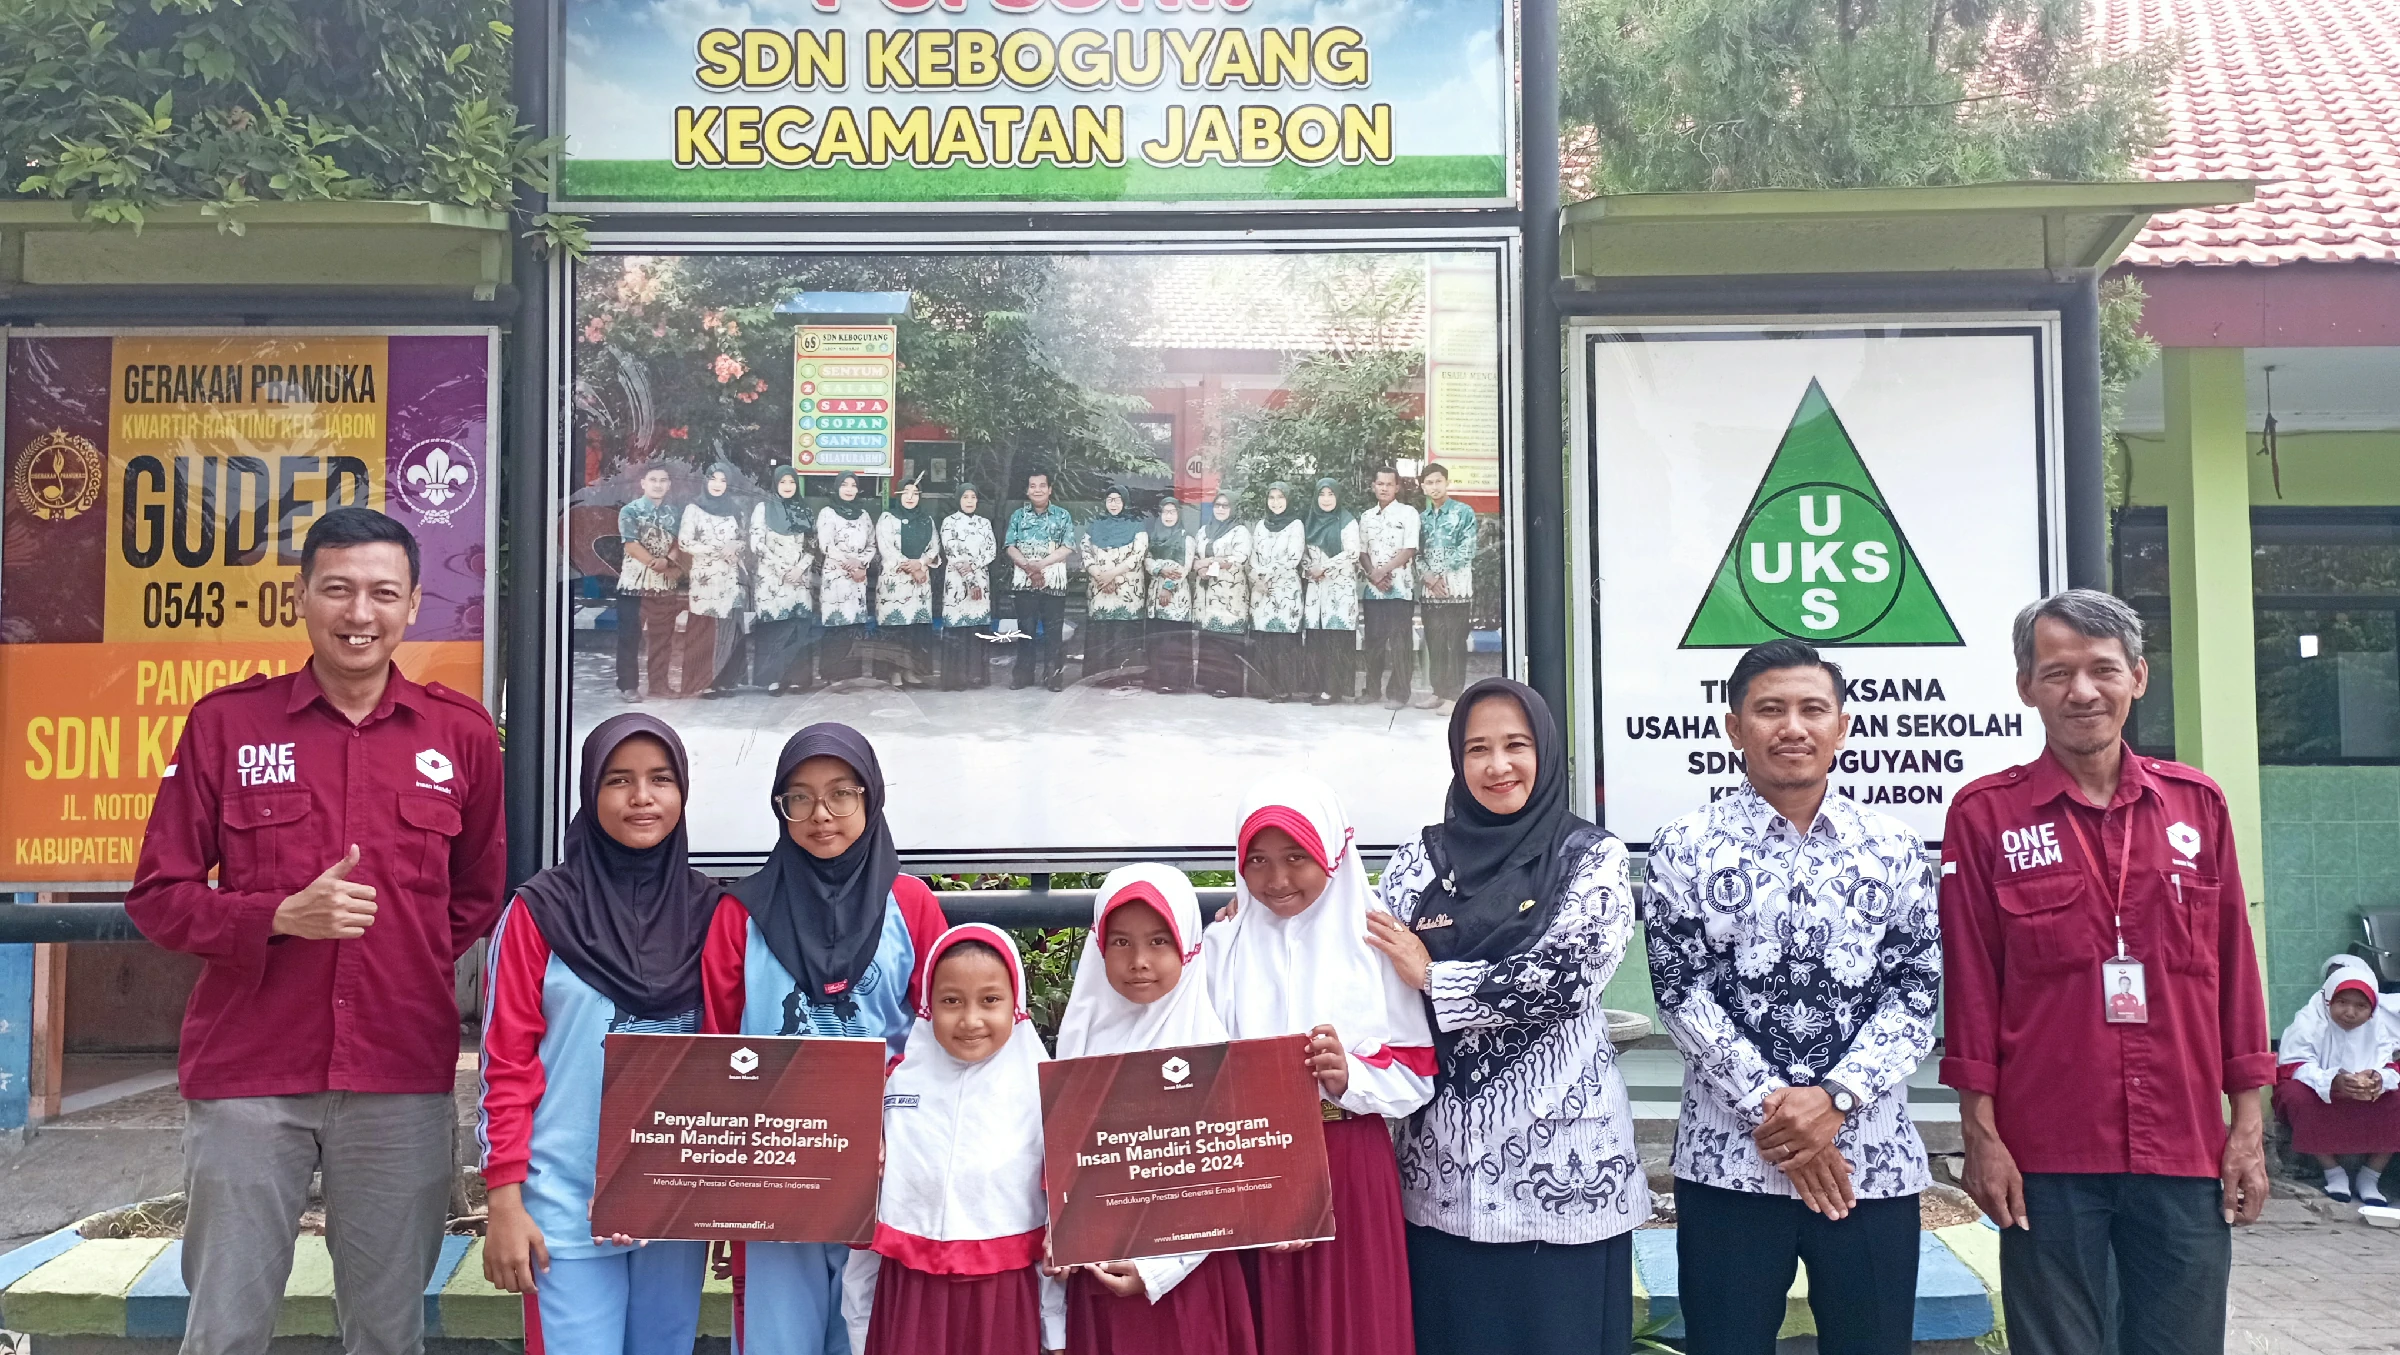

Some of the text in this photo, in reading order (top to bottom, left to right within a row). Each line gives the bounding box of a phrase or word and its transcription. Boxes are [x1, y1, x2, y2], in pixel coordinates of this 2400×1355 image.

[694, 25, 1369, 89] SDN KEBOGUYANG
[673, 102, 1393, 166] KECAMATAN JABON
[124, 363, 376, 404] GERAKAN PRAMUKA
[822, 366, 884, 376] SENYUM
[821, 401, 883, 411] SAPA
[121, 411, 376, 439] KWARTIR RANTING KEC. JABON
[821, 418, 883, 428] SOPAN
[820, 436, 883, 446] SANTUN
[1750, 541, 1890, 585] UKS
[144, 581, 225, 629] 0543
[1626, 716, 1722, 740] USAHA
[1896, 713, 2023, 737] SEKOLAH
[25, 715, 120, 780] SDN
[238, 742, 296, 768] ONE
[237, 764, 296, 787] TEAM
[1688, 752, 1747, 774] SDN
[60, 794, 87, 821] JL.
[1862, 785, 1943, 804] JABON
[2001, 822, 2059, 852] ONE
[15, 837, 134, 865] KABUPATEN
[2004, 845, 2063, 873] TEAM
[653, 1111, 828, 1132] Penyaluran Program
[1096, 1116, 1269, 1147] Penyaluran Program
[630, 1128, 849, 1152] Insan Mandiri Scholarship
[1076, 1130, 1293, 1167] Insan Mandiri Scholarship
[680, 1149, 797, 1166] Periode 2024
[1129, 1154, 1245, 1181] Periode 2024
[653, 1178, 820, 1190] Mendukung Prestasi Generasi Emas Indonesia
[1105, 1182, 1273, 1207] Mendukung Prestasi Generasi Emas Indonesia
[694, 1219, 775, 1230] www.insanmandiri.id
[1154, 1228, 1234, 1243] www.insanmandiri.id
